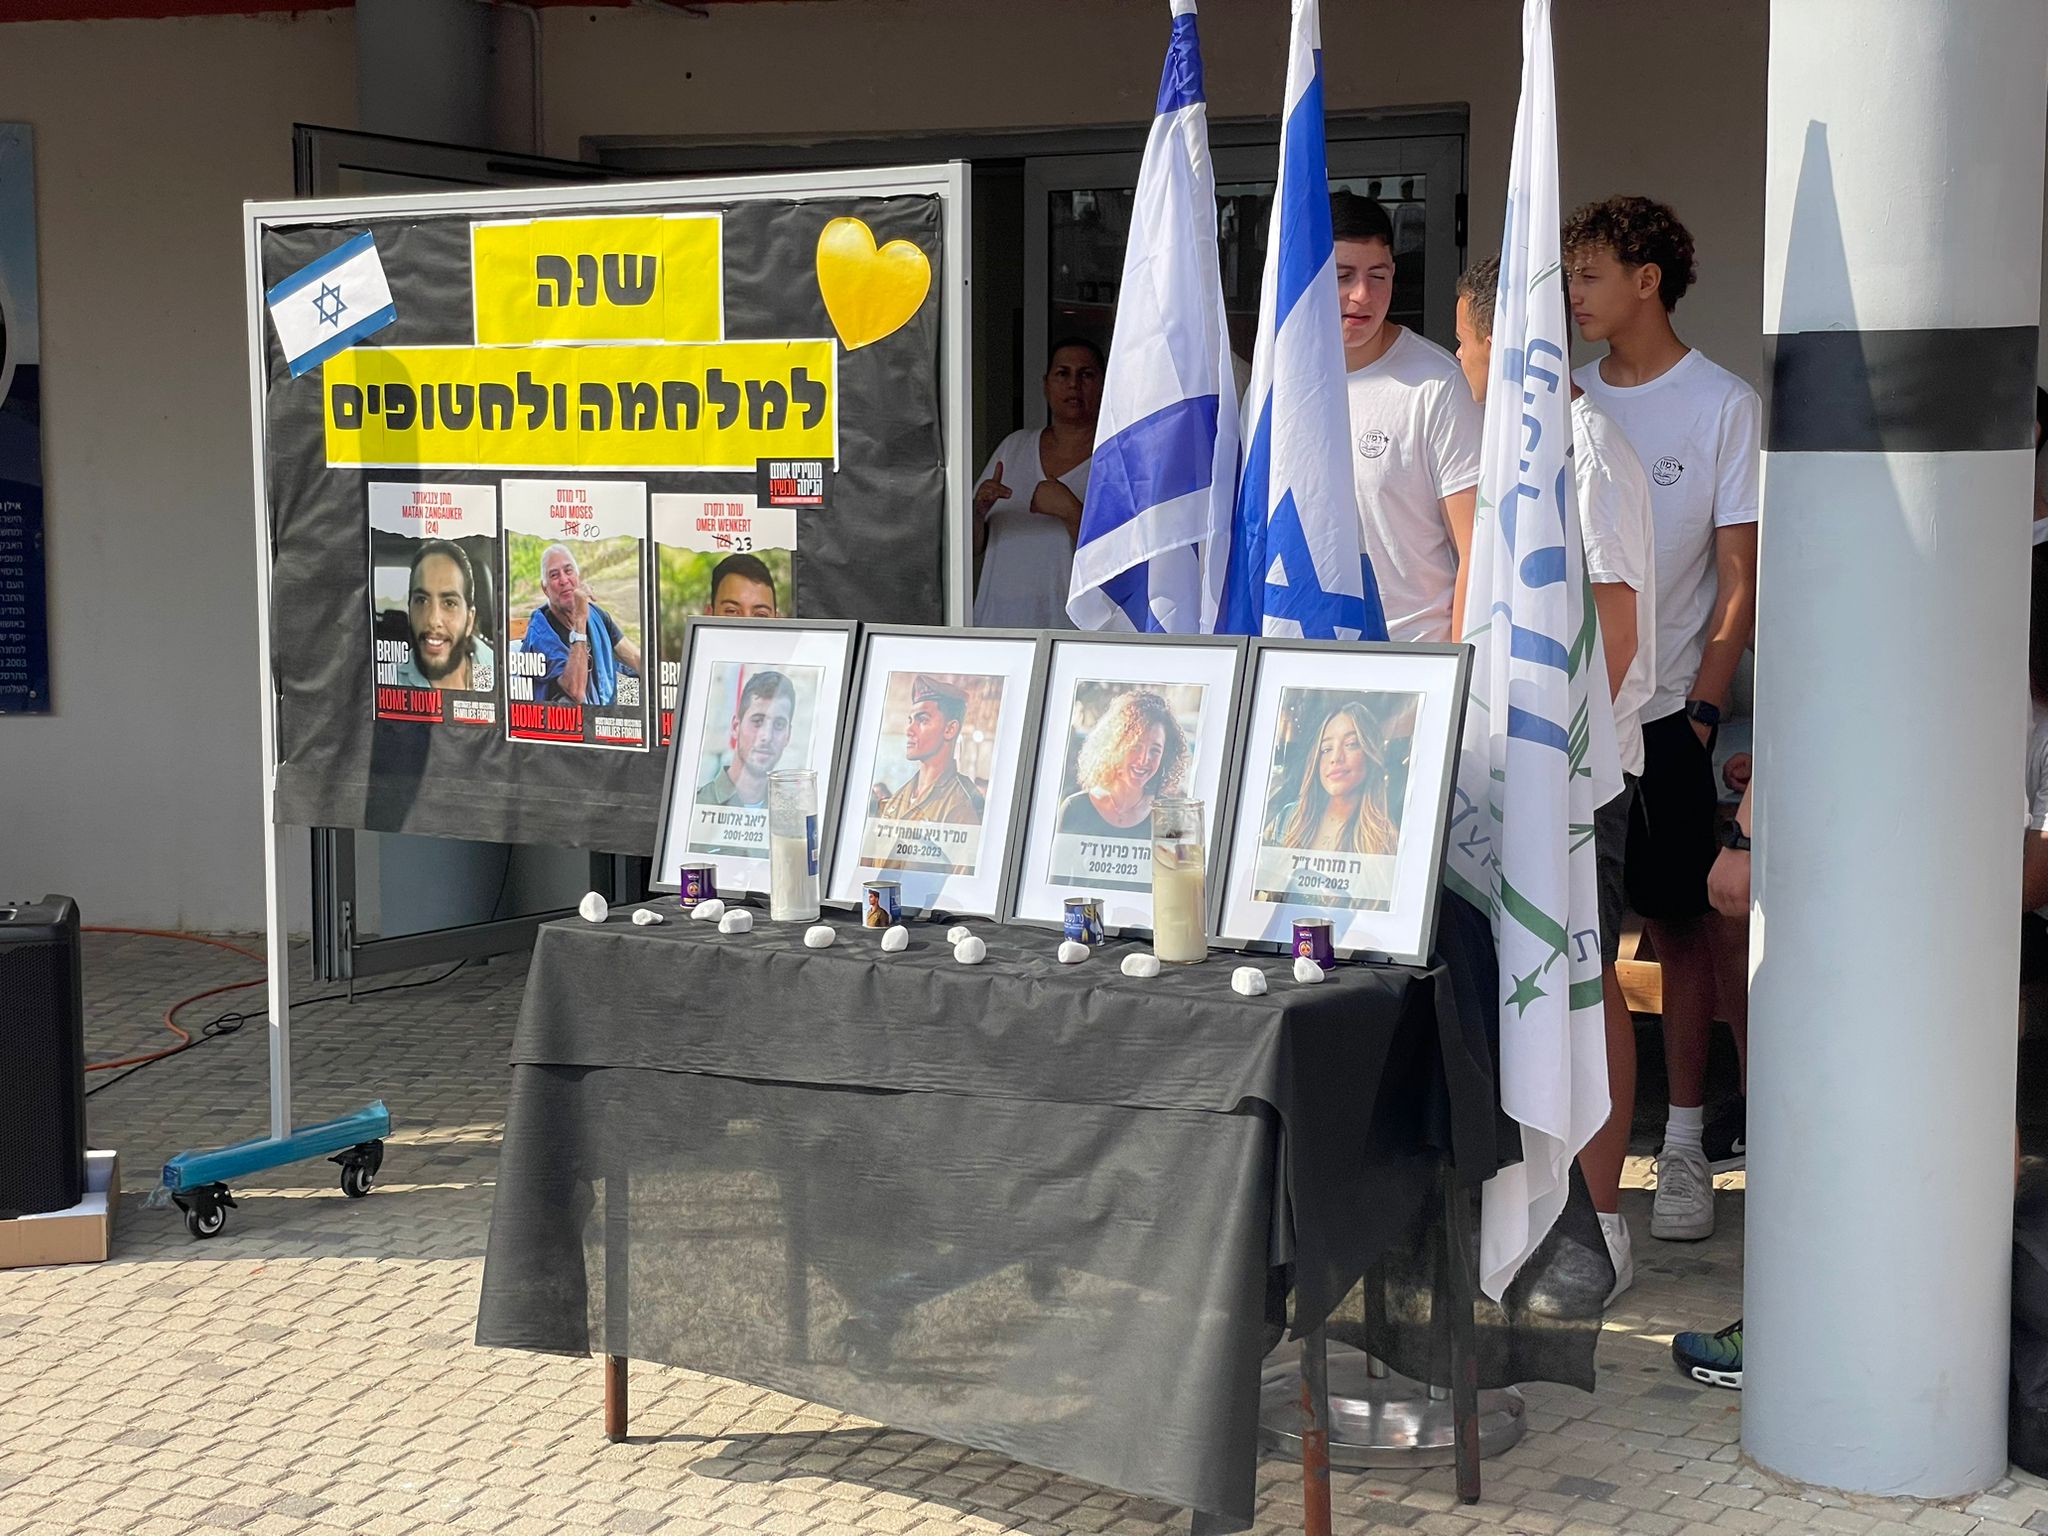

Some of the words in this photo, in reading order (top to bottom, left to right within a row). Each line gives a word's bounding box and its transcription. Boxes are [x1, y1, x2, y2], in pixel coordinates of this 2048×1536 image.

[535, 253, 658, 307] שנה
[331, 371, 566, 431] ולחטופים
[579, 367, 828, 431] למלחמה
[796, 479, 822, 496] הביתה
[575, 489, 587, 503] גדי
[4, 501, 22, 512] אילן
[402, 505, 423, 518] MATAN
[424, 506, 463, 520] ZANGAUKER
[550, 504, 567, 519] GADI
[568, 505, 593, 519] MOSES
[425, 520, 439, 535] (24)
[583, 523, 600, 538] 80
[696, 518, 716, 531] OMER
[717, 518, 751, 532] WENKERT
[735, 537, 752, 551] 23
[376, 639, 409, 664] BRING
[6, 659, 27, 667] 2003
[509, 651, 546, 677] BRING
[377, 662, 398, 686] HIM
[510, 676, 534, 701] HIM
[378, 688, 408, 711] HOME
[410, 688, 443, 714] NOW!
[511, 703, 545, 728] HOME
[547, 705, 583, 732] NOW!
[717, 812, 744, 826] אלוש
[744, 814, 767, 828] ליאב
[723, 829, 764, 842] 2001-2023
[895, 826, 923, 840] שמחי
[924, 828, 941, 842] גיא
[896, 843, 942, 857] 2003-2023
[1100, 844, 1129, 859] פרינץ
[1131, 846, 1151, 860] הדר
[1089, 861, 1138, 875] 2002-2023
[1313, 857, 1346, 874] מזרחי
[1349, 860, 1362, 875] רז
[1298, 875, 1350, 890] 2001-2023
